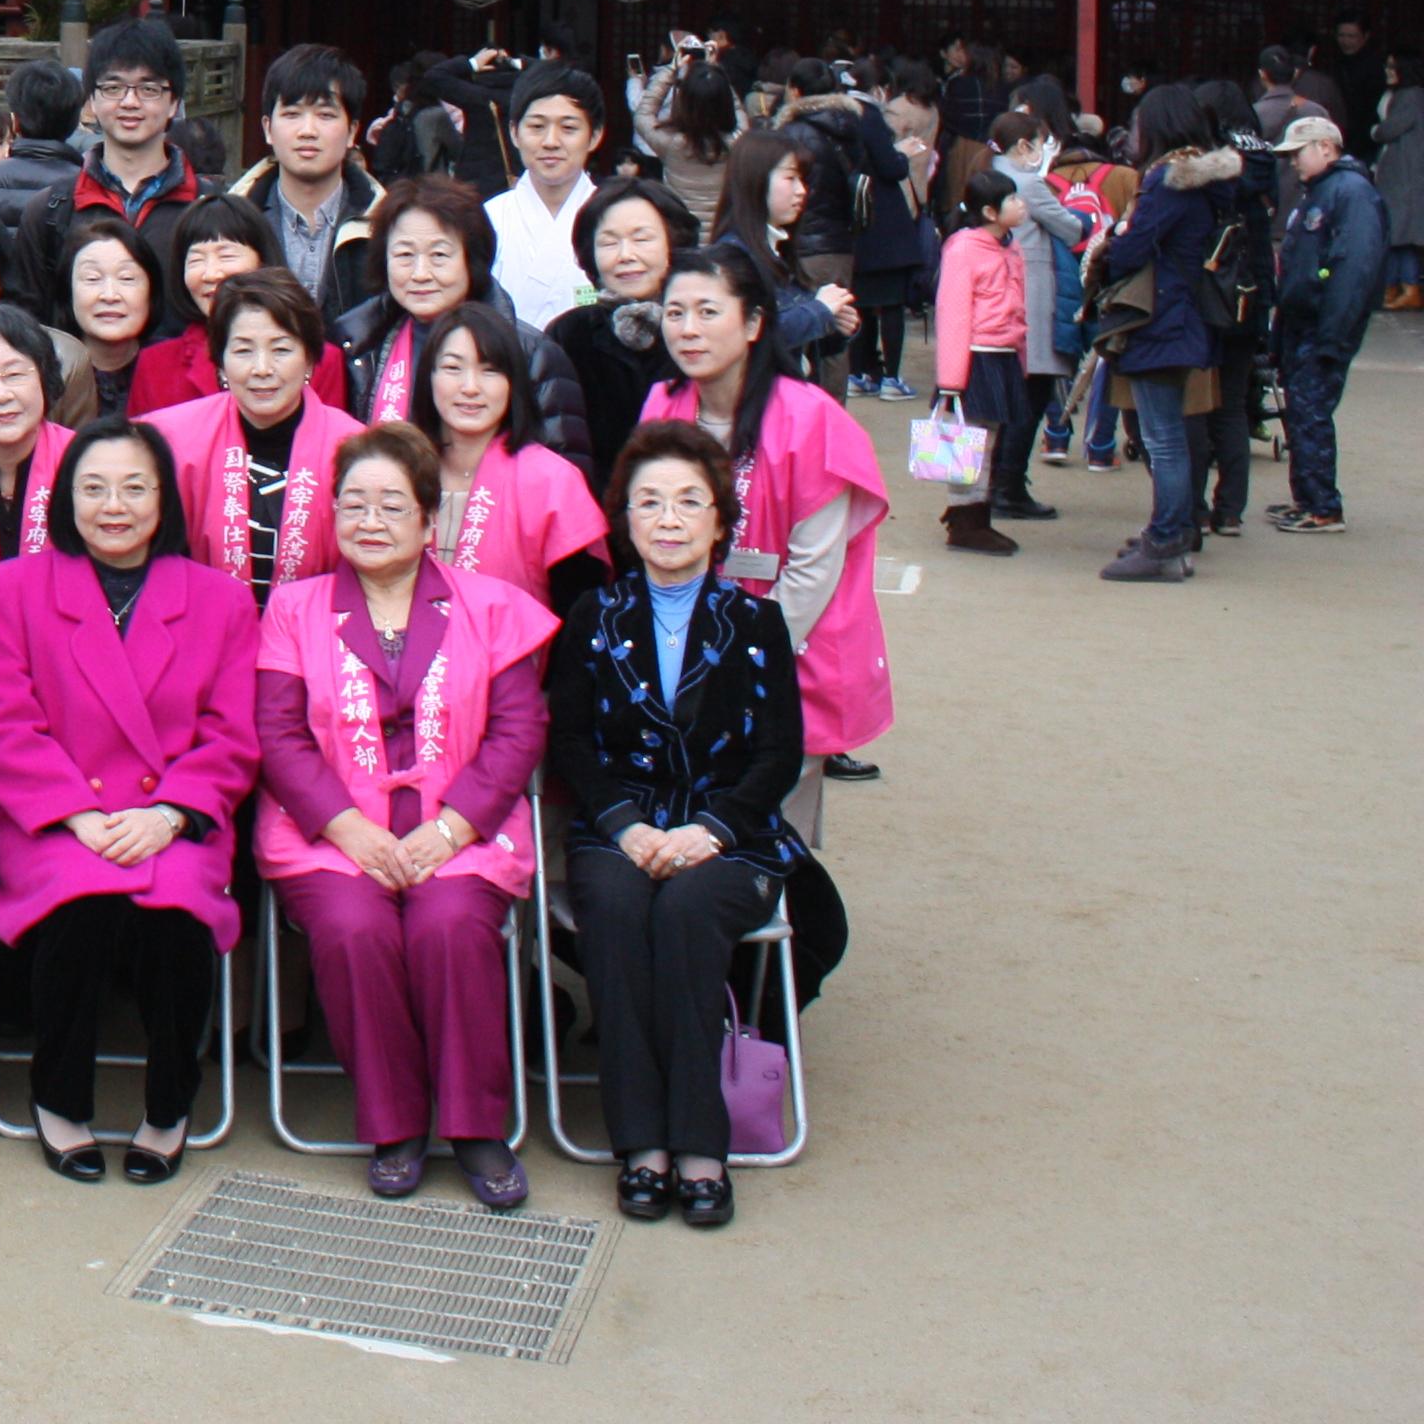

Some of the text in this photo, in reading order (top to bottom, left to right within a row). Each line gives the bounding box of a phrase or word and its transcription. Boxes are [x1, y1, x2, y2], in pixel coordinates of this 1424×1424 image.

[337, 612, 378, 774] 奉仕婦人部
